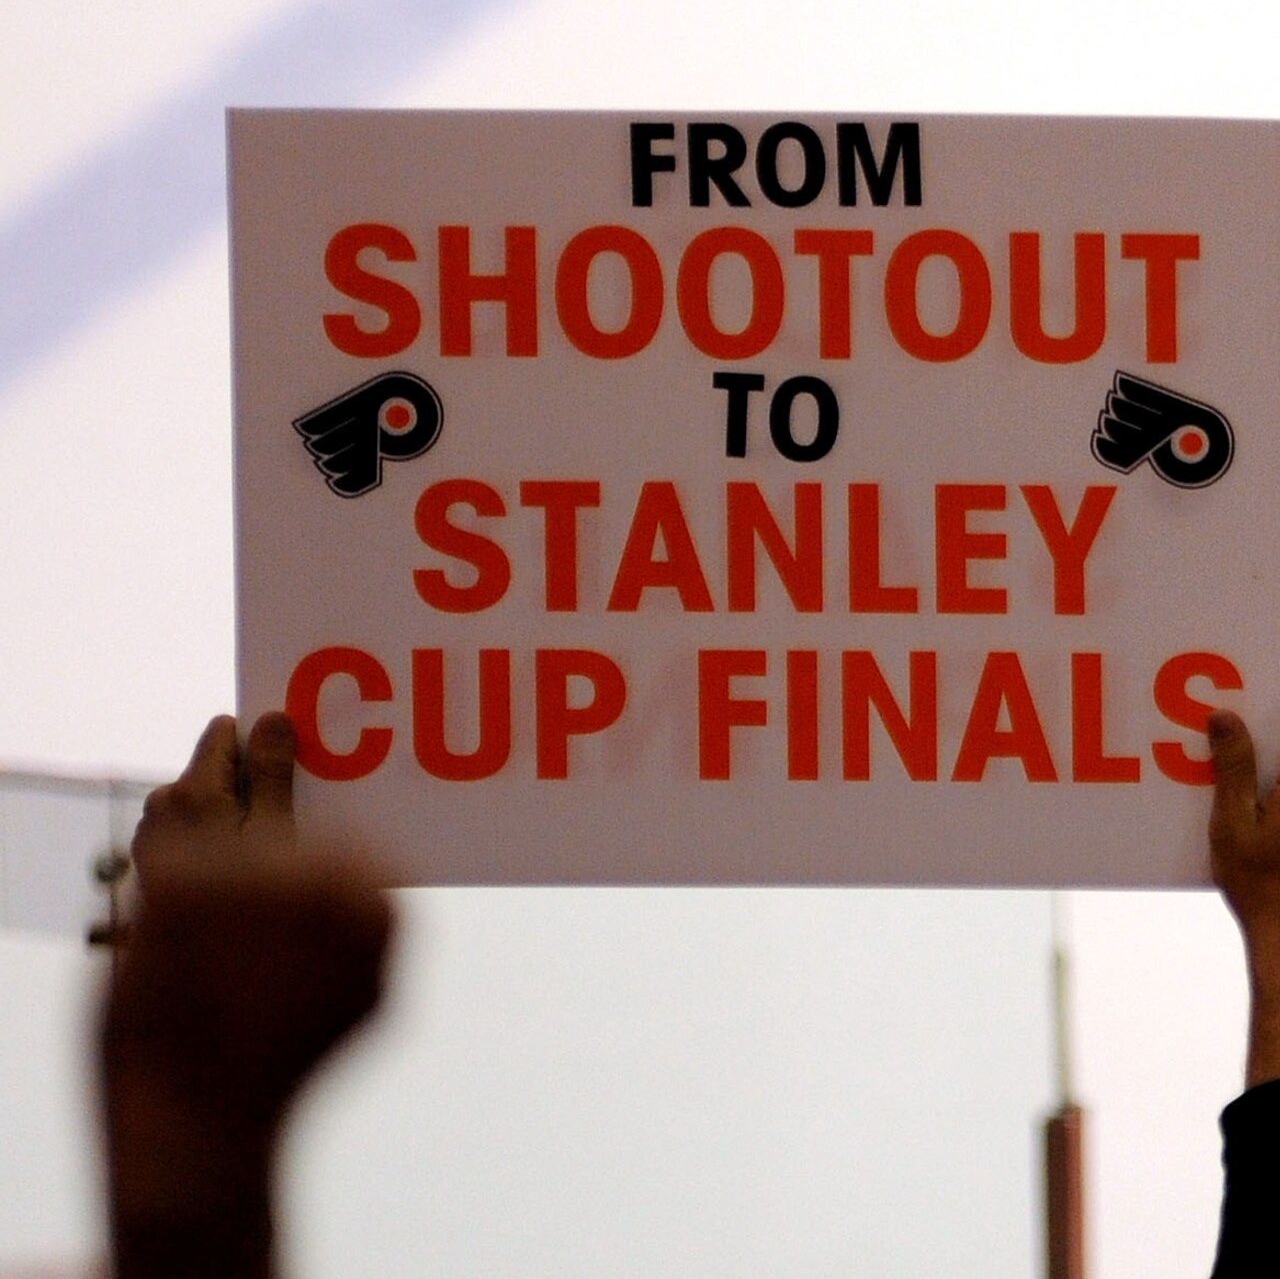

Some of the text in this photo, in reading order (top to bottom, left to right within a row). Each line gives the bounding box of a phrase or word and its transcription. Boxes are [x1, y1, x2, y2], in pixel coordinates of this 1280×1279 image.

[628, 121, 924, 210] FROM
[321, 221, 1203, 366] SHOOTOUT
[711, 370, 841, 464] TO
[411, 477, 1119, 617] STANLEY
[283, 644, 1245, 788] CUP FINALS
